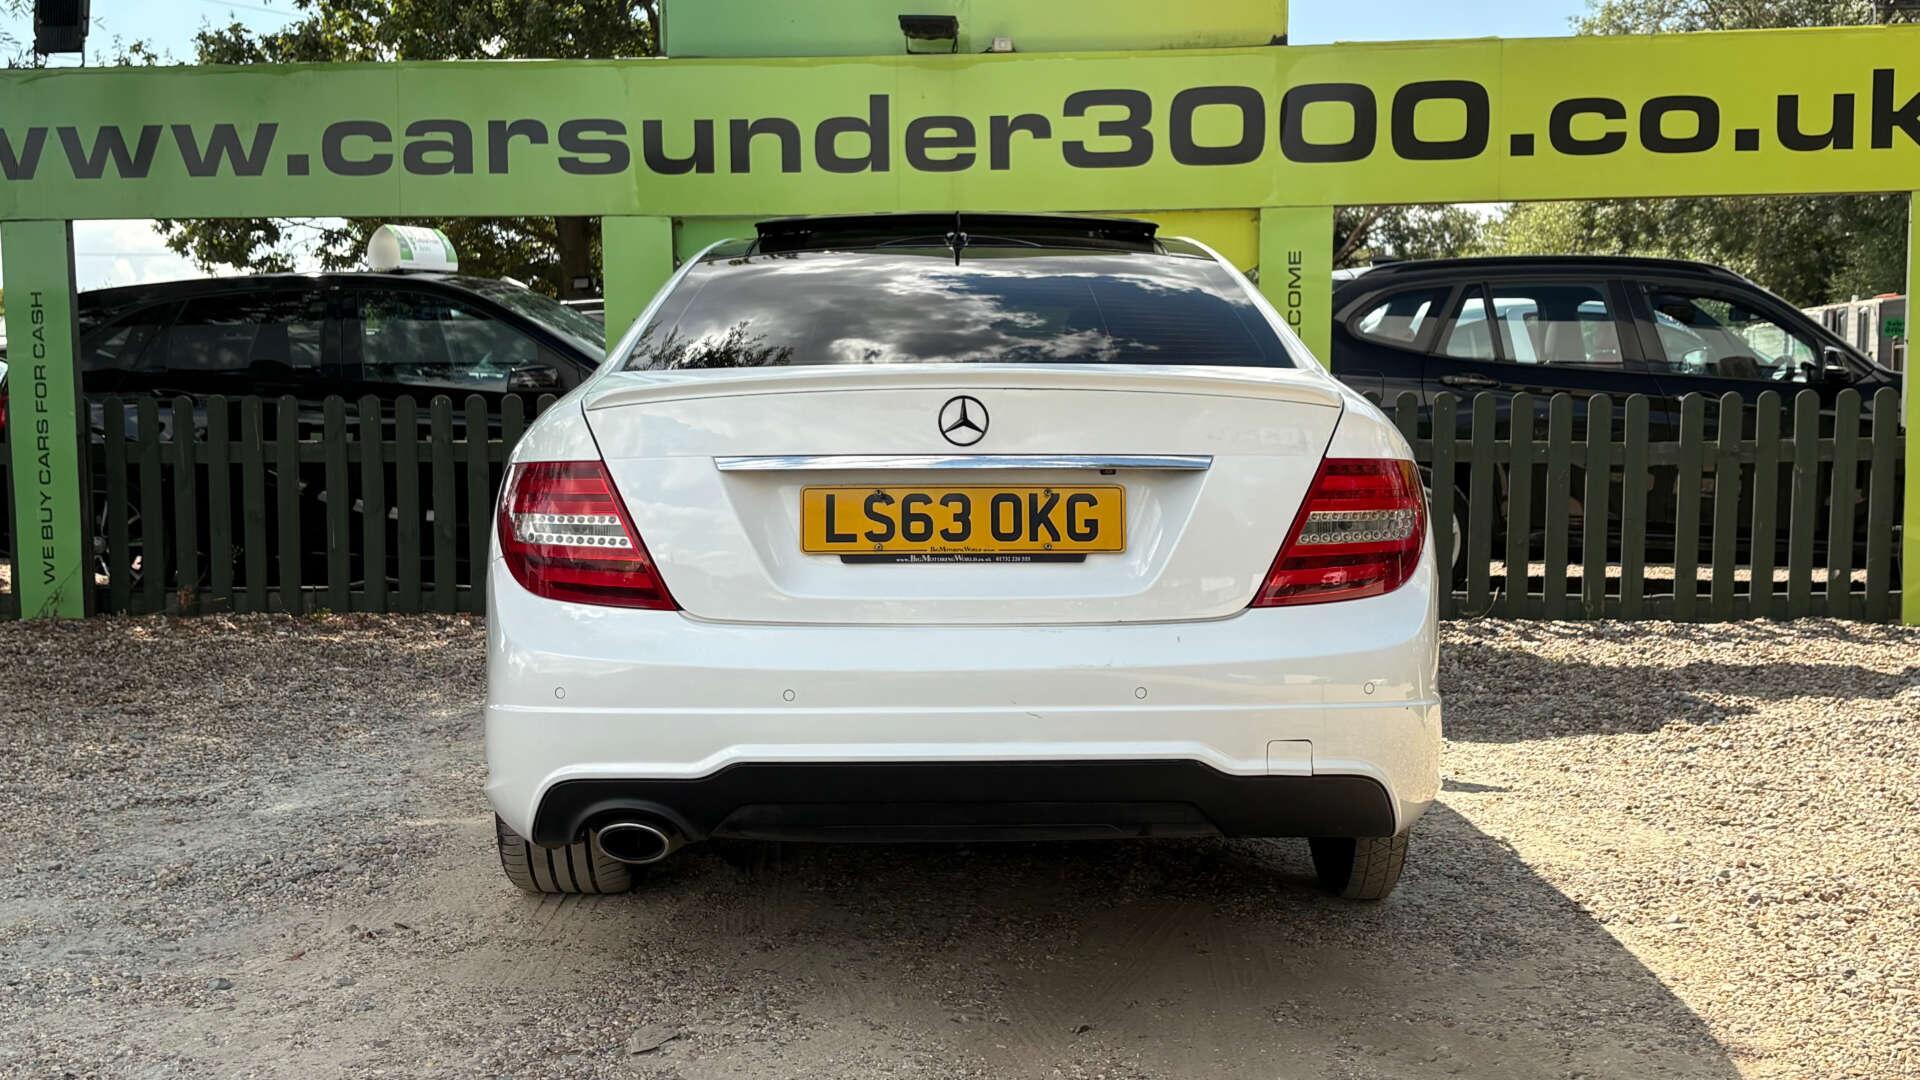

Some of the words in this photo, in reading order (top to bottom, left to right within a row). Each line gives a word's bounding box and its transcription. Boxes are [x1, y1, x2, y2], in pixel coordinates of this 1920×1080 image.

[30, 291, 46, 359] CASH
[34, 364, 48, 413] FOR
[36, 418, 51, 485] CARS
[40, 490, 54, 540] BUY
[825, 493, 972, 543] LS63
[990, 493, 1099, 543] OKG
[42, 546, 55, 585] WE
